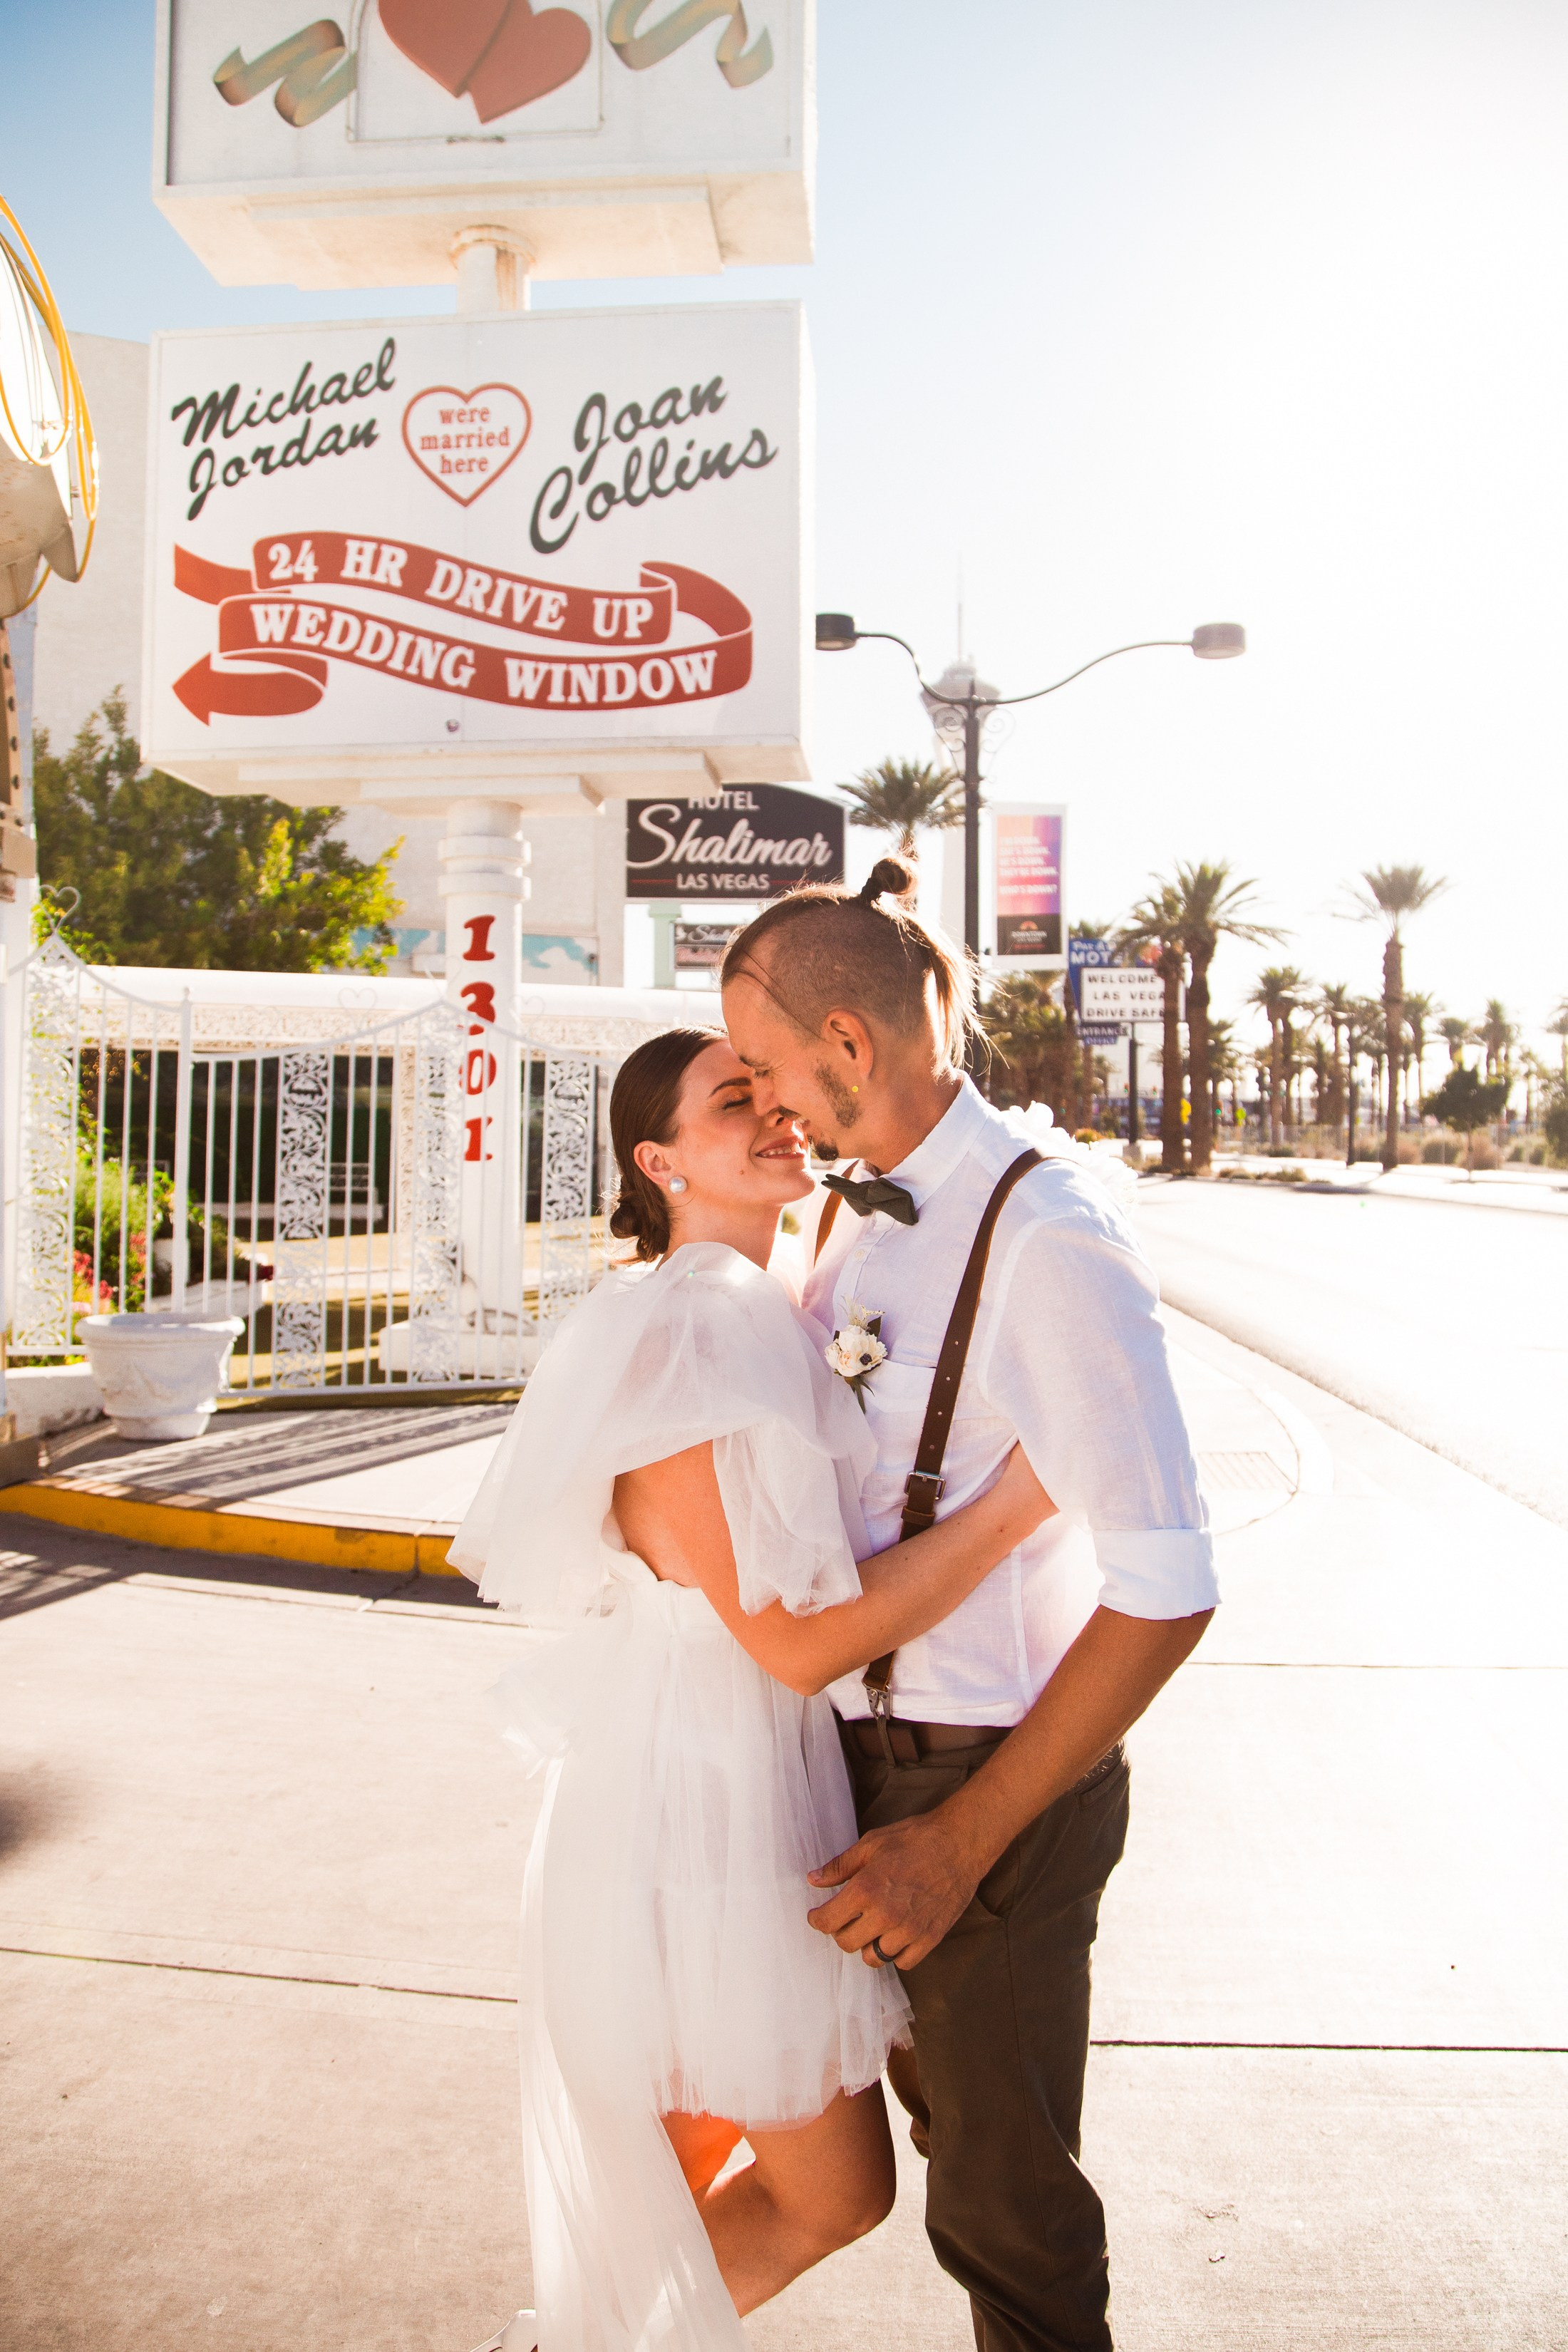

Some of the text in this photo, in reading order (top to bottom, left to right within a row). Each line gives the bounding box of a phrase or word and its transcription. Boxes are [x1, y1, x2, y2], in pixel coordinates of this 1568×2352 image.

[171, 336, 396, 447] Michael
[439, 406, 490, 424] were
[421, 425, 510, 450] married
[573, 375, 728, 485] Joan
[187, 417, 379, 522] Jordan
[440, 453, 489, 474] here
[530, 428, 779, 555] Collins
[268, 538, 654, 639] 24 HR DRIVE UP
[249, 603, 719, 704] WEDDING WINDOW
[687, 790, 760, 810] HOTEL
[626, 803, 833, 869] Shalimar
[678, 873, 770, 891] LAS VEGAS
[1088, 974, 1157, 984] WELCOME
[1093, 991, 1165, 1000] LAS VEGA
[1087, 1008, 1127, 1017] DRIVE
[458, 913, 497, 1162] 1301
[1076, 1026, 1128, 1036] ENTRANCE
